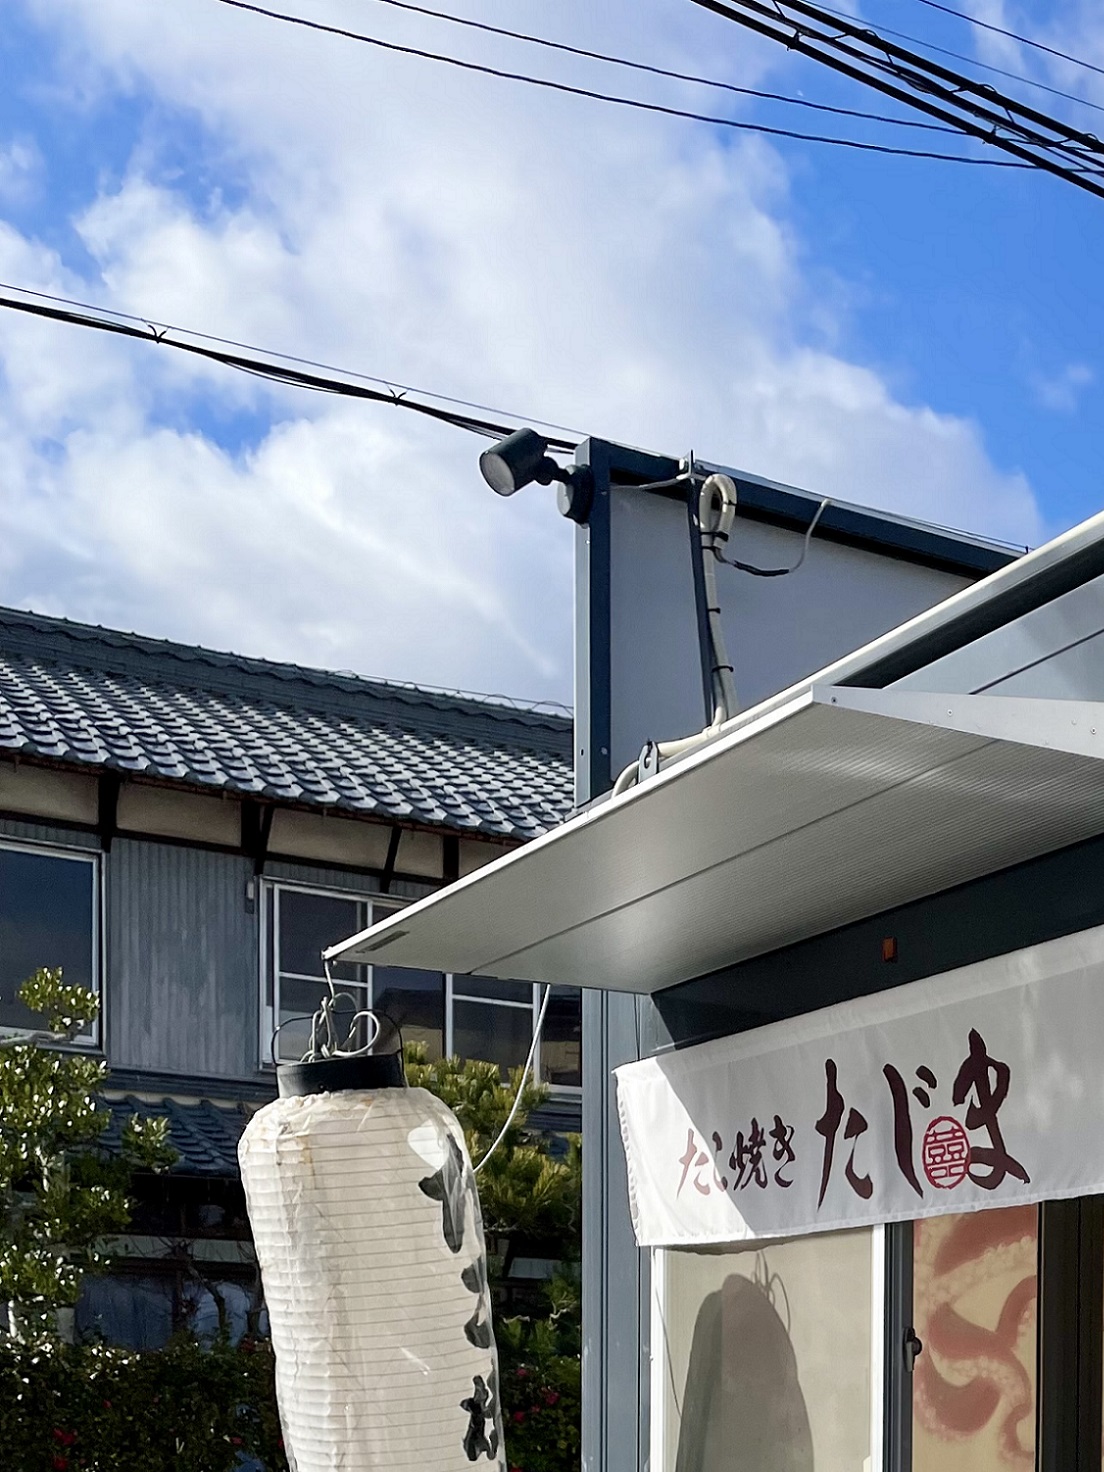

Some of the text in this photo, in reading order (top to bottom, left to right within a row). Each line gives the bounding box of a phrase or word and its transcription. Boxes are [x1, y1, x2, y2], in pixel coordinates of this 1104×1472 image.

[676, 1028, 1031, 1210] たこ焼き たじま
